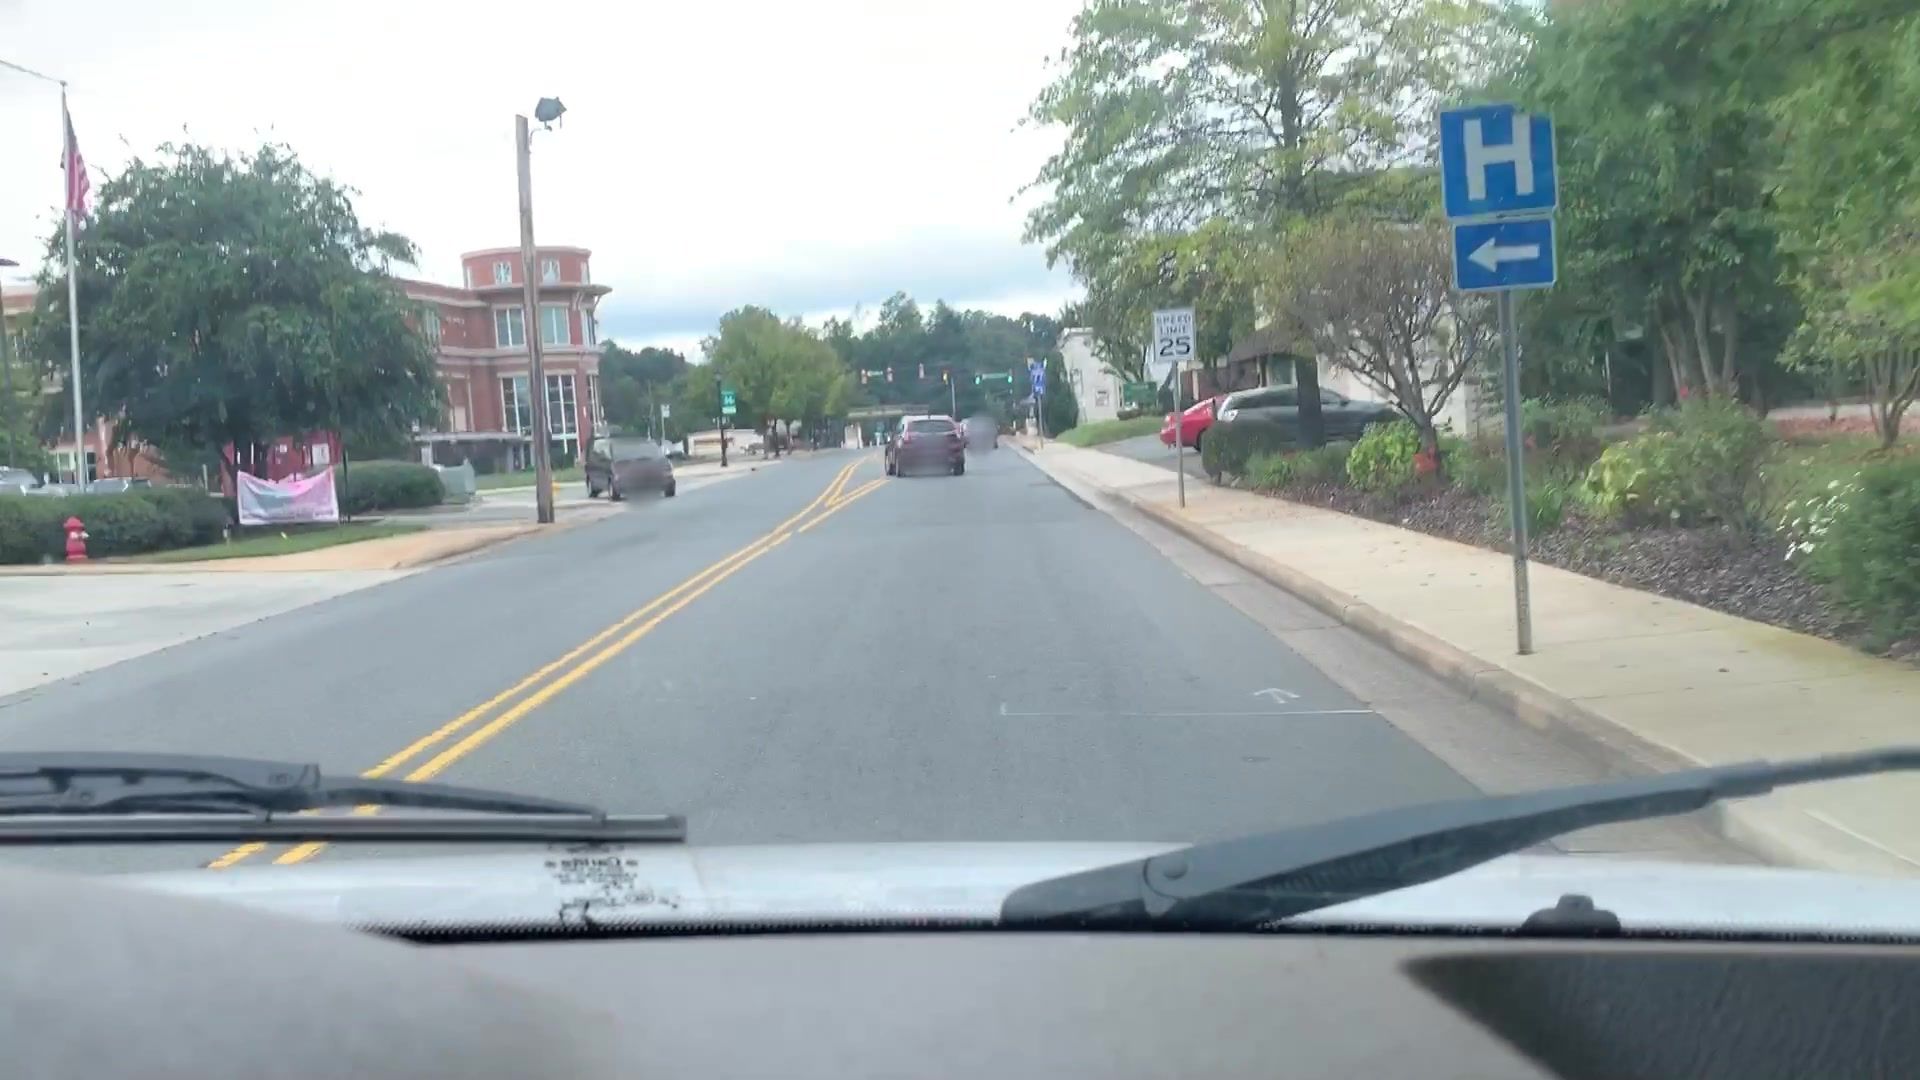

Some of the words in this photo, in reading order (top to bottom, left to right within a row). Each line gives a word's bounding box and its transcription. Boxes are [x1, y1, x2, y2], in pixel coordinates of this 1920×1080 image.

[1463, 114, 1534, 201] H
[1156, 313, 1191, 324] SPEED
[1160, 324, 1188, 335] LIMIT
[1160, 336, 1190, 356] 25
